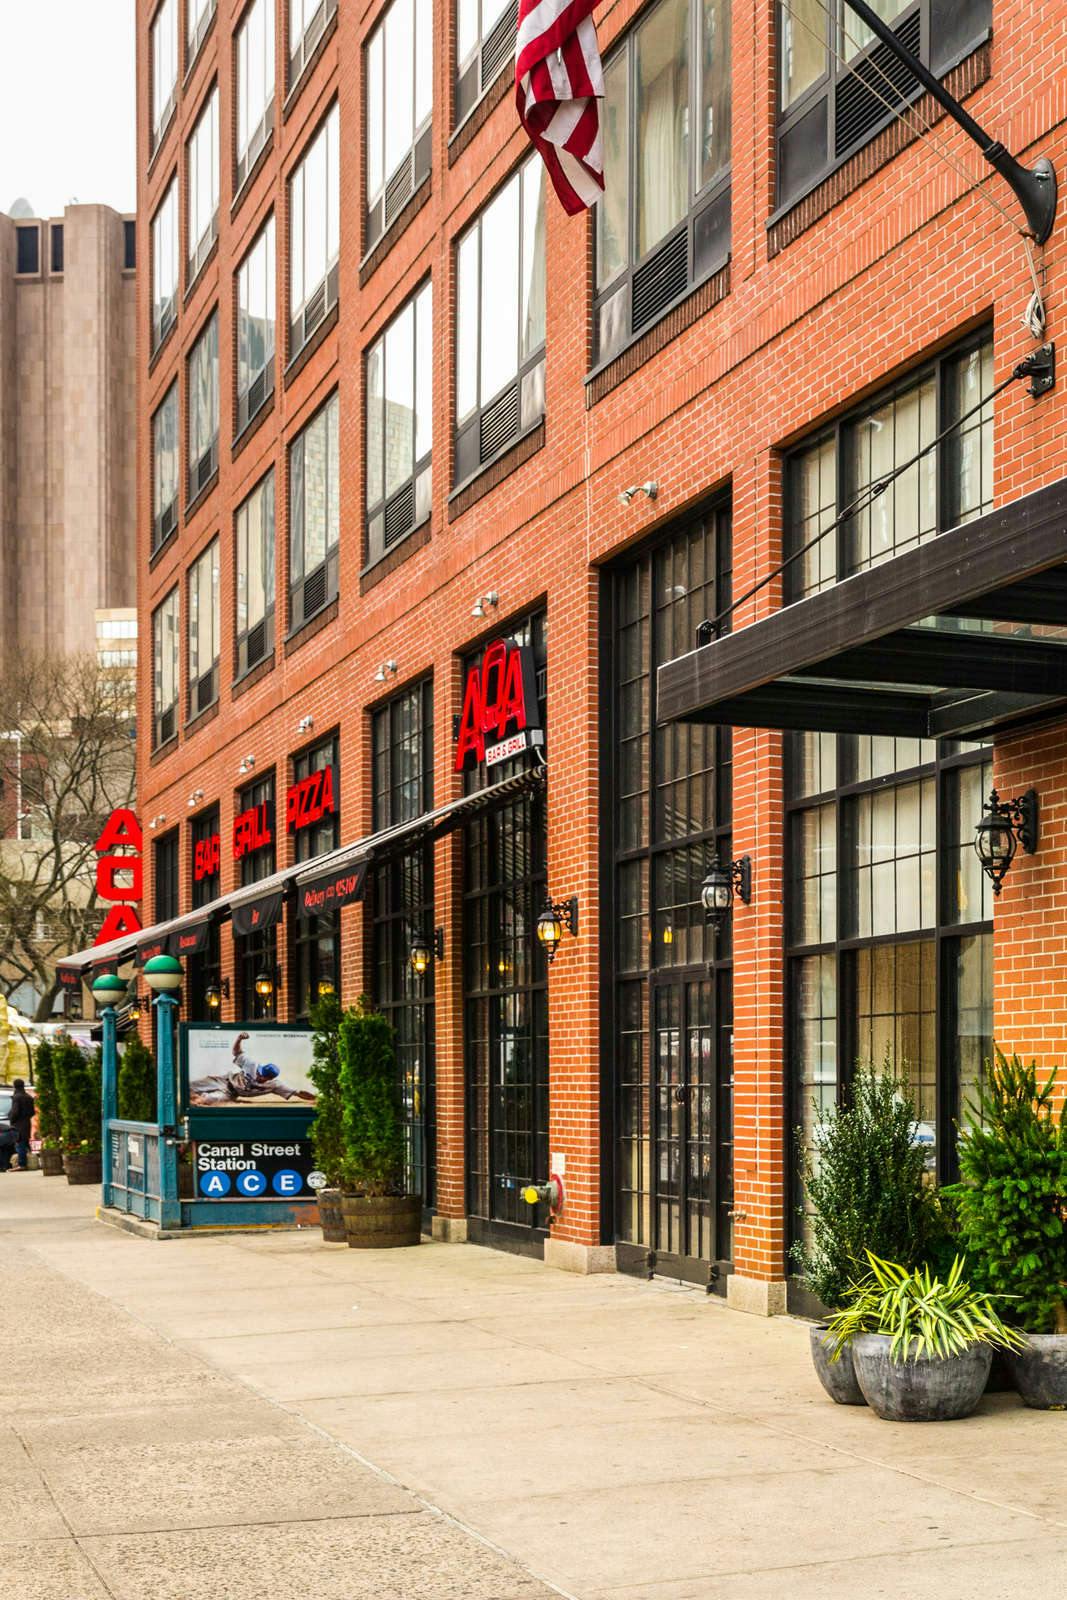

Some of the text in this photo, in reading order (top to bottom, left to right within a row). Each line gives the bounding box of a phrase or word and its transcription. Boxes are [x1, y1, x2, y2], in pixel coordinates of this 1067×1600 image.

[454, 638, 527, 773] AOA
[286, 764, 335, 834] PIZZA
[194, 832, 220, 881] BAR
[233, 800, 271, 861] GRILL
[94, 808, 143, 948] AOA
[198, 1143, 302, 1157] Canal Street
[198, 1157, 257, 1171] Station
[207, 1174, 295, 1192] A C E
